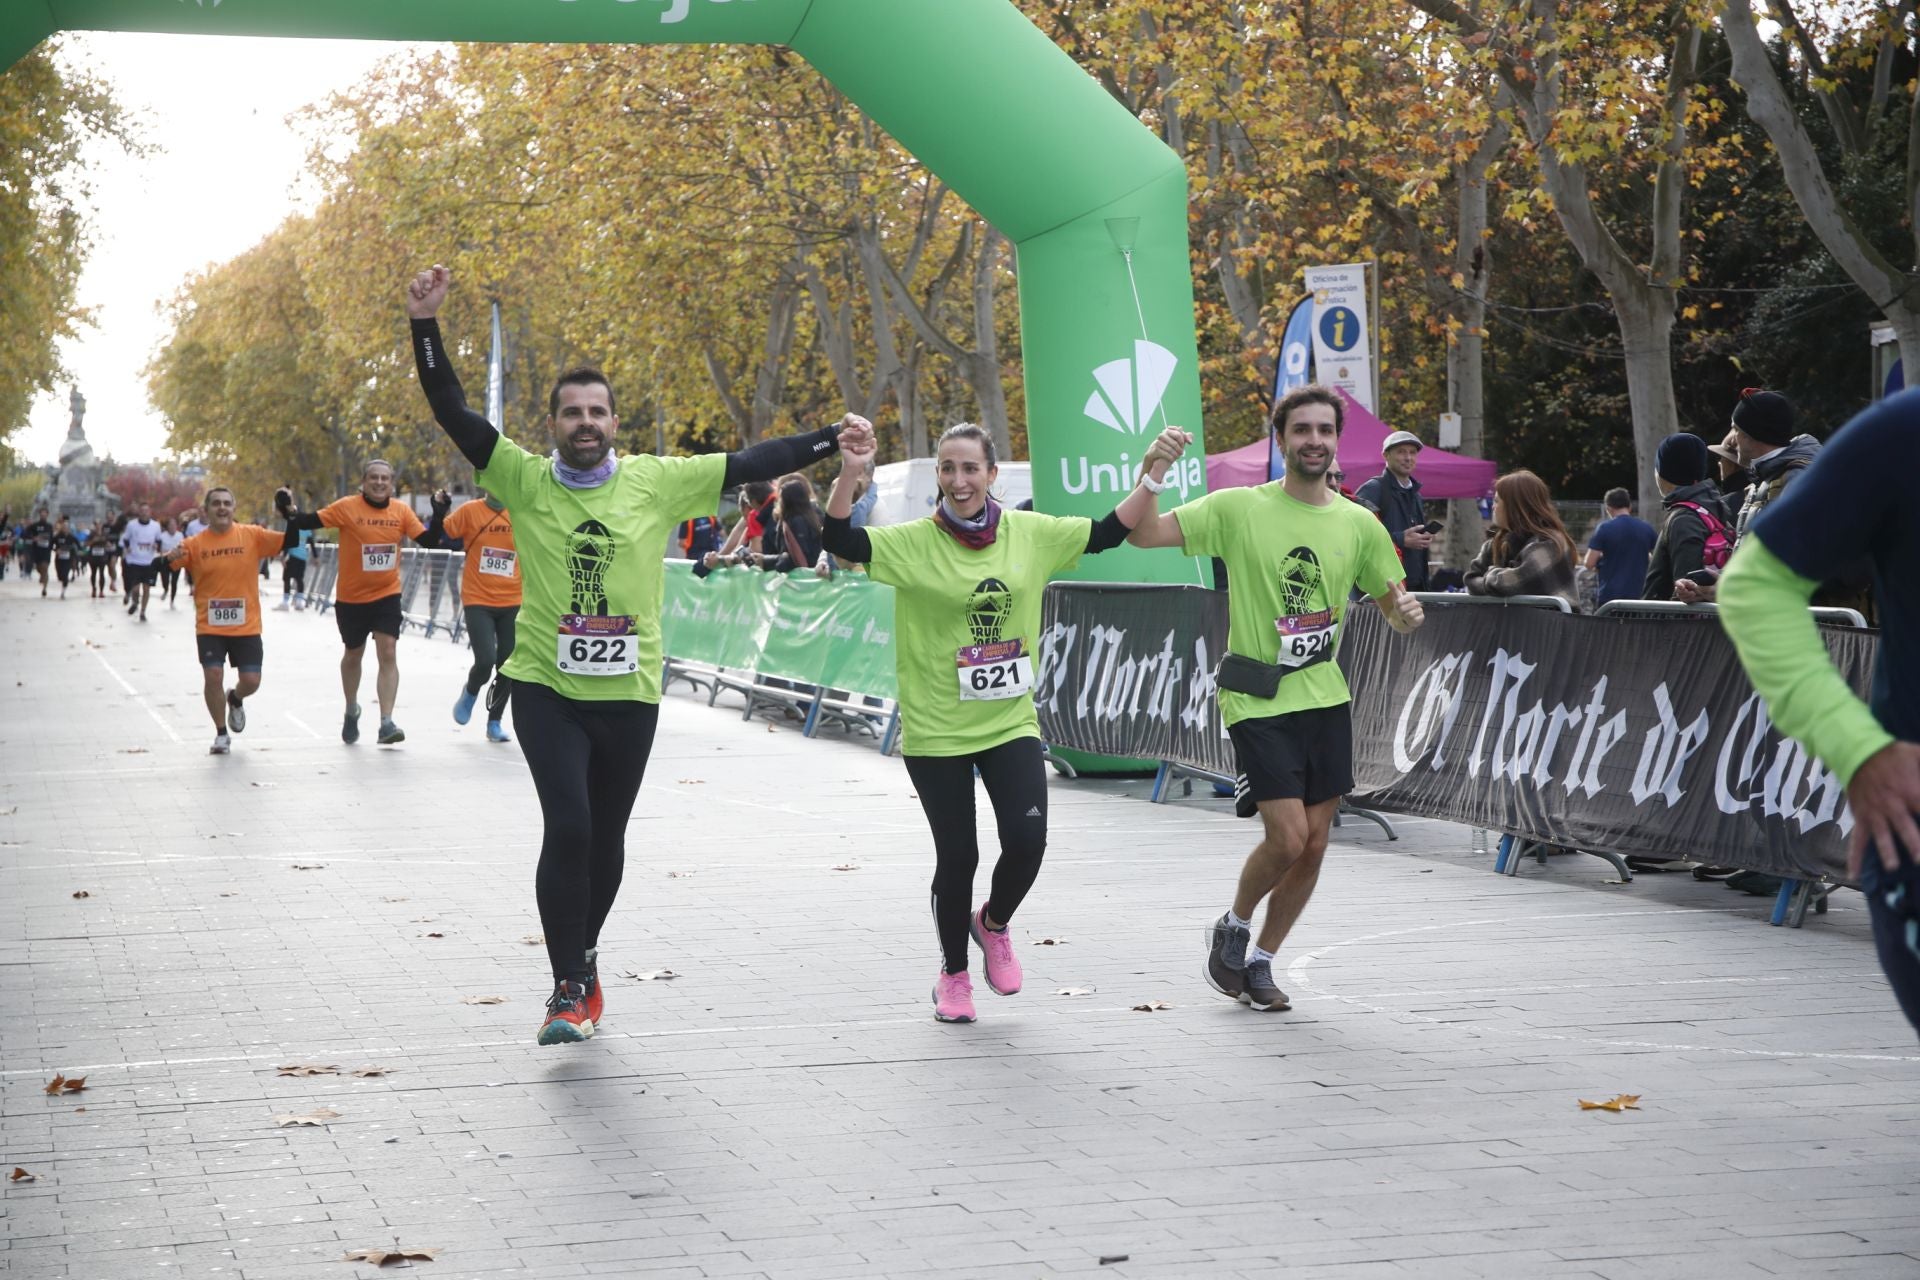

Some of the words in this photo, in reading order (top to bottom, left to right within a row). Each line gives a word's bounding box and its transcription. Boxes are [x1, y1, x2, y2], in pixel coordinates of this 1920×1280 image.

[423, 337, 436, 368] KIPRUN
[211, 547, 244, 556] LIFETEC
[369, 554, 391, 566] 987
[486, 557, 508, 571] 985
[214, 608, 238, 620] 986
[570, 638, 626, 663] 622
[1291, 630, 1332, 658] 620
[970, 661, 1020, 691] 621
[1033, 621, 1077, 715] El
[1076, 622, 1183, 725] Norte
[1393, 650, 1473, 774] El
[1467, 647, 1627, 800] Norte
[1629, 681, 1709, 809] de
